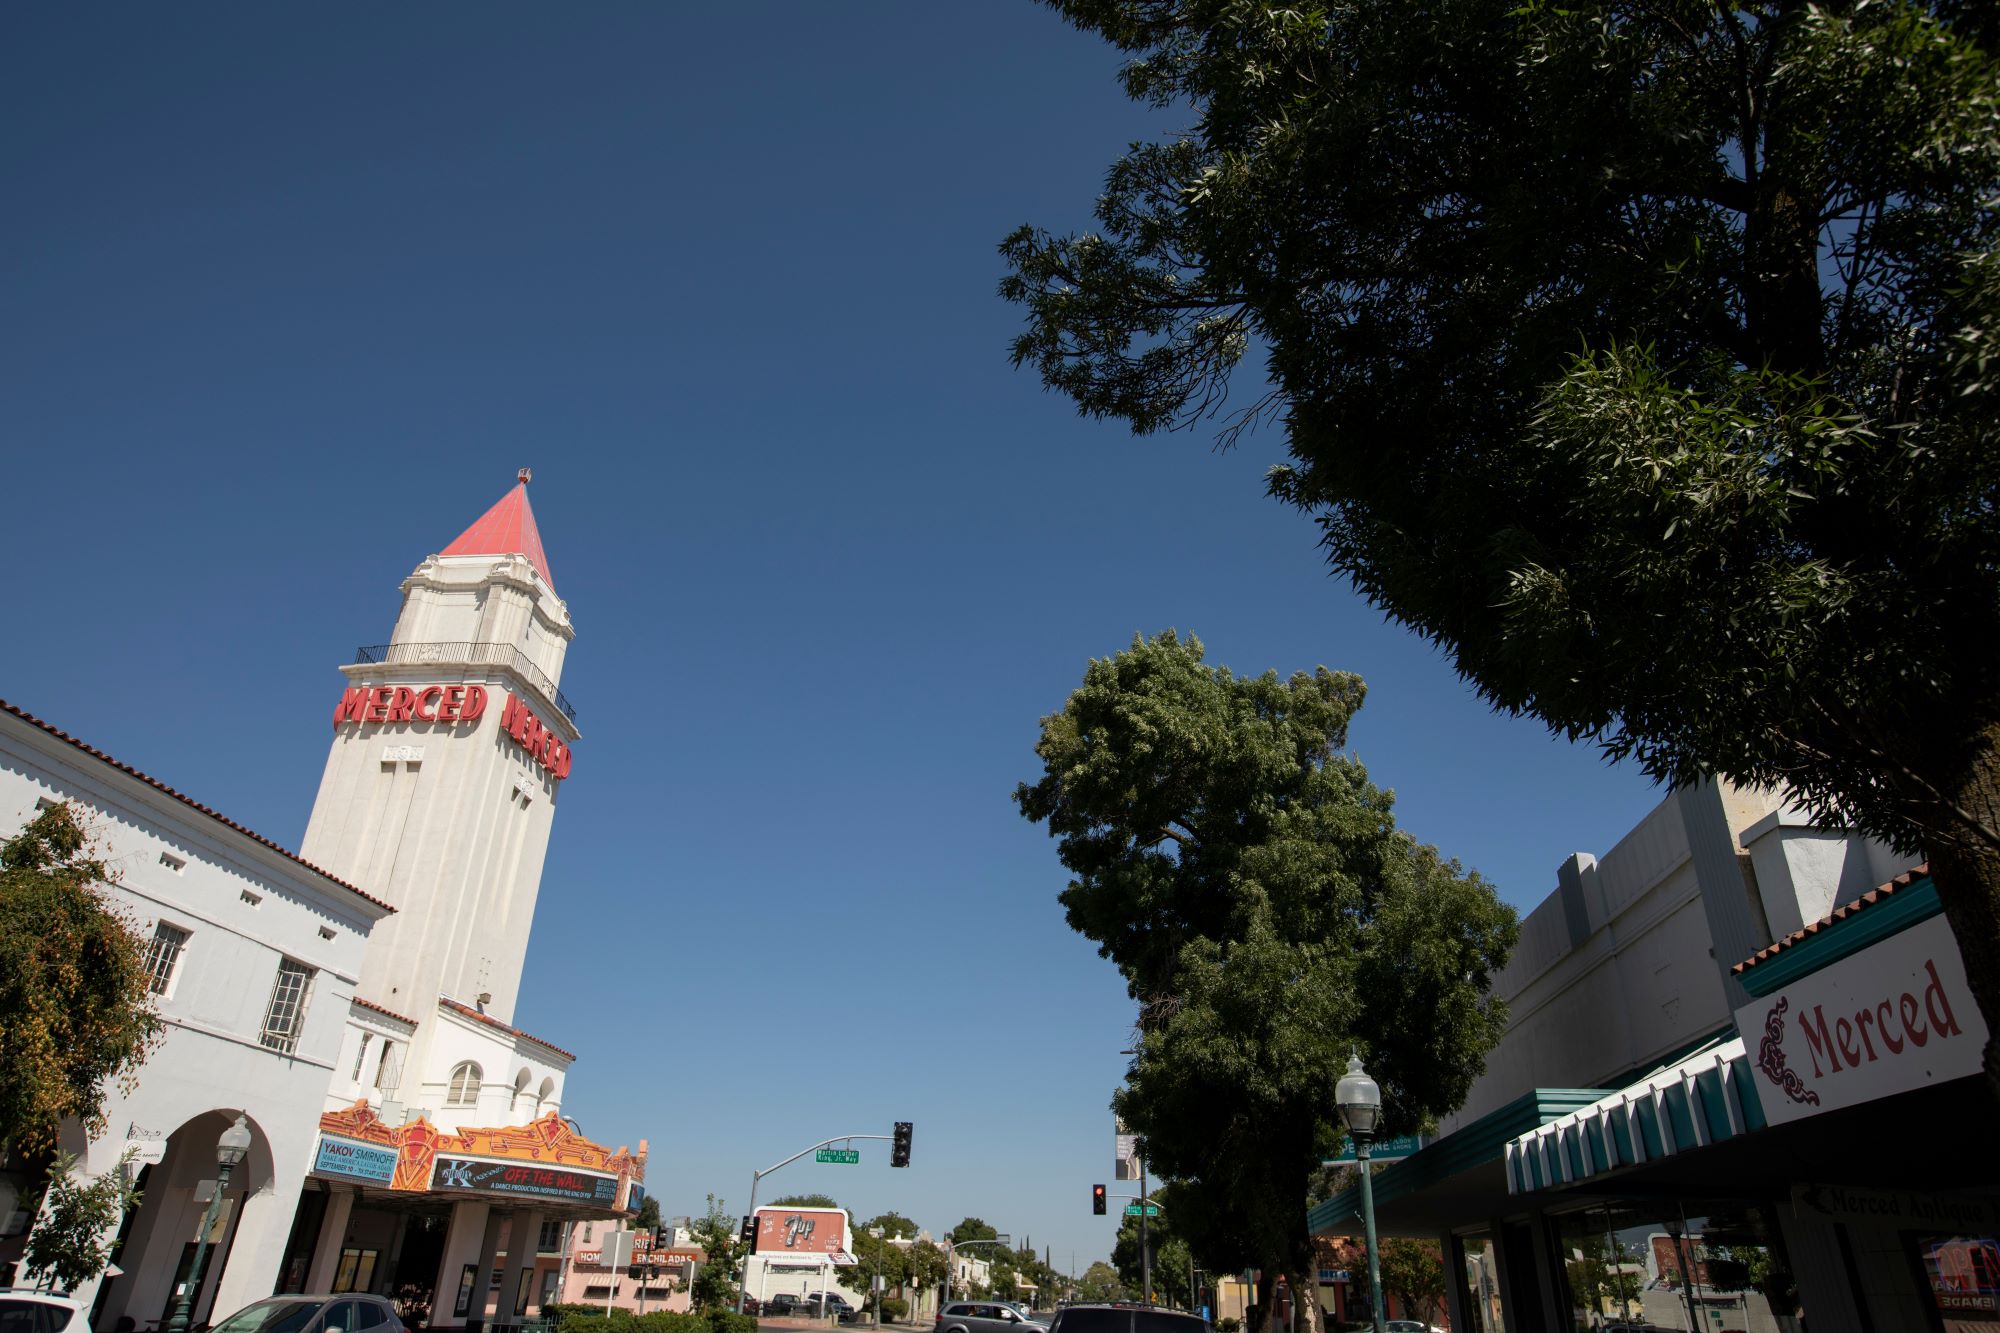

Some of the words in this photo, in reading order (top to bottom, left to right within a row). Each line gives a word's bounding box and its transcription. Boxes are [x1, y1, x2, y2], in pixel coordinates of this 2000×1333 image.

[333, 685, 489, 732] MERCED
[501, 692, 572, 780] MERCED
[1798, 958, 1963, 1079] Merced
[321, 1161, 347, 1170] SEPTEMBER
[325, 1143, 355, 1157] YAKOV
[355, 1149, 395, 1165] SMIRNOFF
[505, 1167, 529, 1185] OFF
[533, 1170, 554, 1185] THE
[556, 1173, 585, 1190] WALL
[511, 1184, 540, 1193] PRODUCTION
[540, 1186, 558, 1194] INSPIRED
[1831, 1188, 1900, 1216] Merced
[636, 1254, 692, 1265] ENCHILADAS
[1934, 1246, 2000, 1291] OPEN
